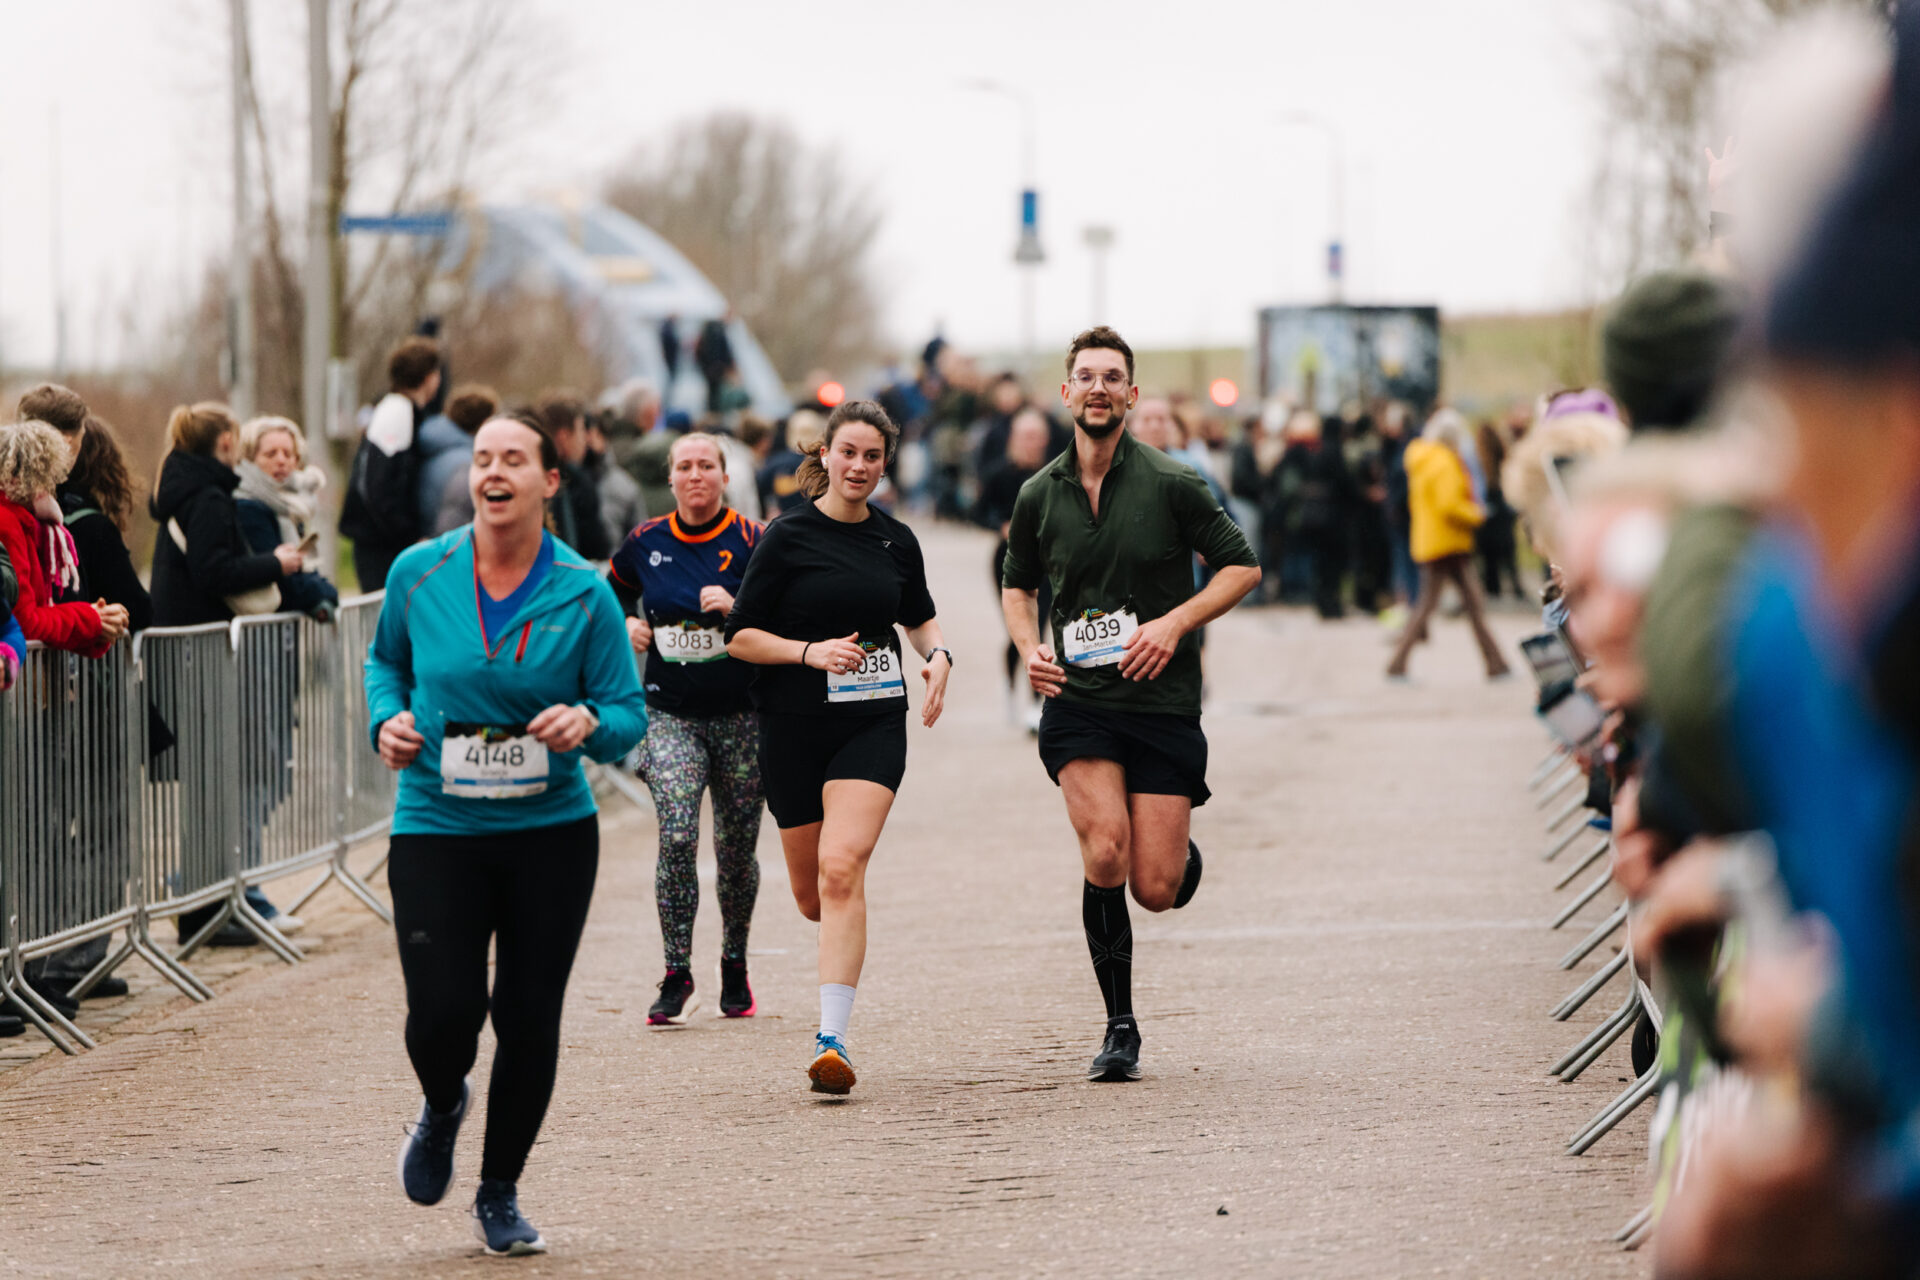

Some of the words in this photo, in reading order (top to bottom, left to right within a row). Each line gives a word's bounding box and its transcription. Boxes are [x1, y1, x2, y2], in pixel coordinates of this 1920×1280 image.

[1075, 618, 1121, 643] 4039
[666, 631, 713, 650] 3083
[1082, 639, 1118, 651] Jan-Marten
[857, 675, 880, 684] Maartje
[465, 745, 525, 767] 4148
